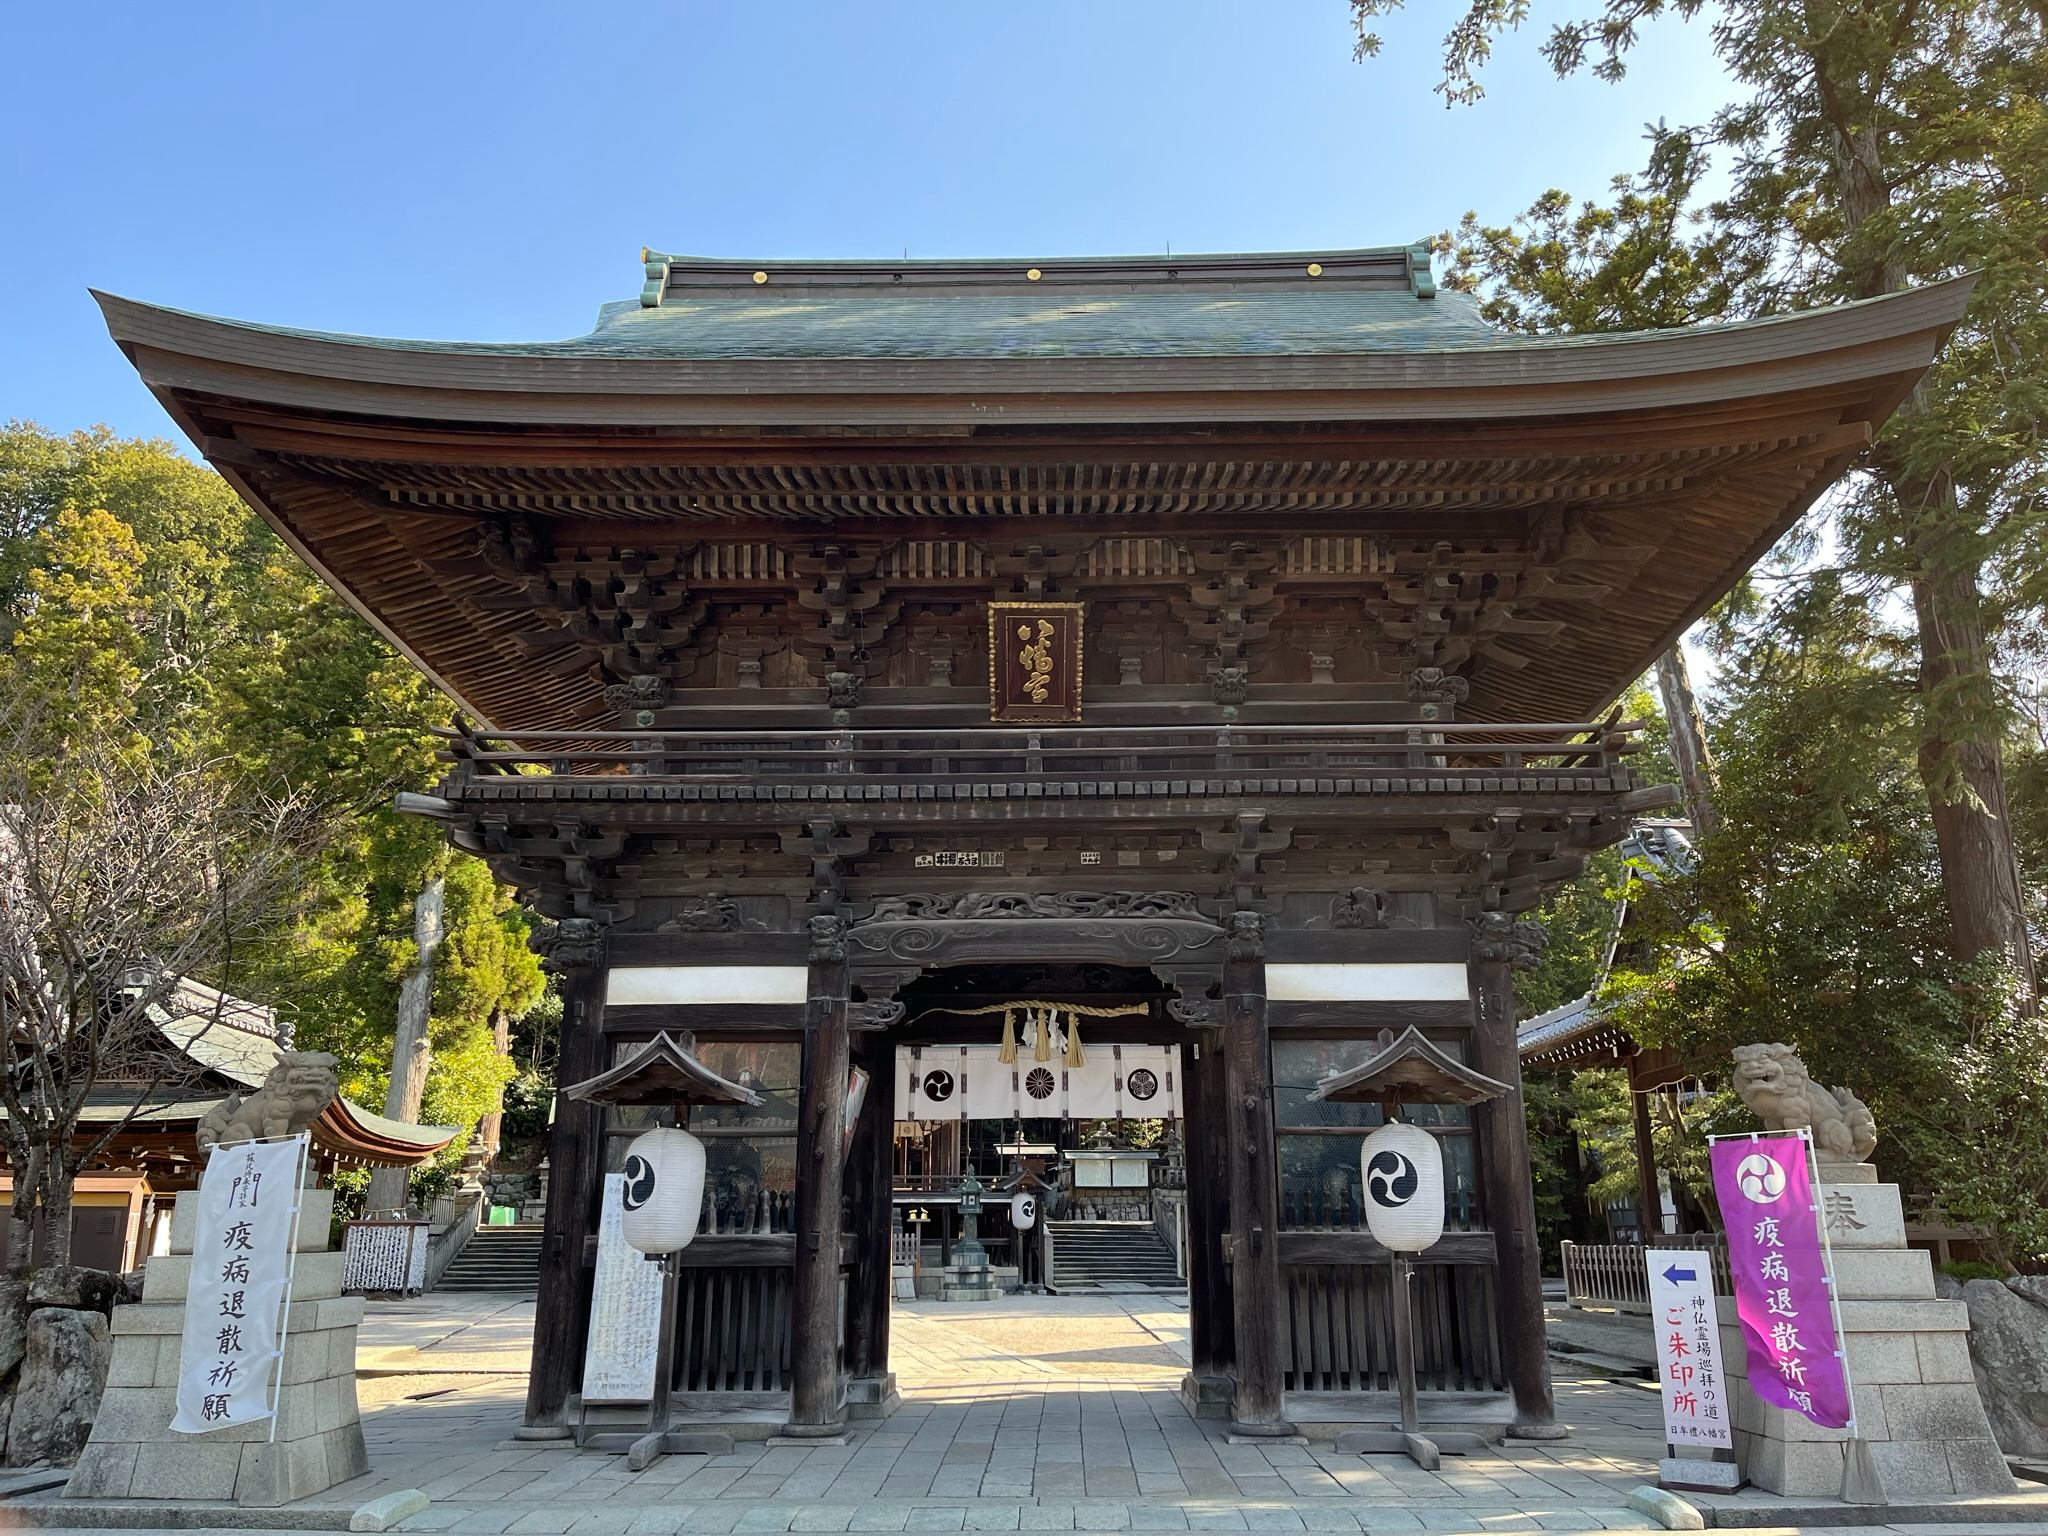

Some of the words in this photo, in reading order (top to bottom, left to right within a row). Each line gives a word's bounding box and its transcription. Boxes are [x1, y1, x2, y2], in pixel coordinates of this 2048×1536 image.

[1018, 619, 1055, 703] 八幡宮
[1825, 1191, 1867, 1238] 奉
[201, 1221, 254, 1421] 疫病退散祈願
[1666, 1306, 1698, 1418] ご朱印所
[1691, 1295, 1719, 1420] 神仏霊場巡拝の道
